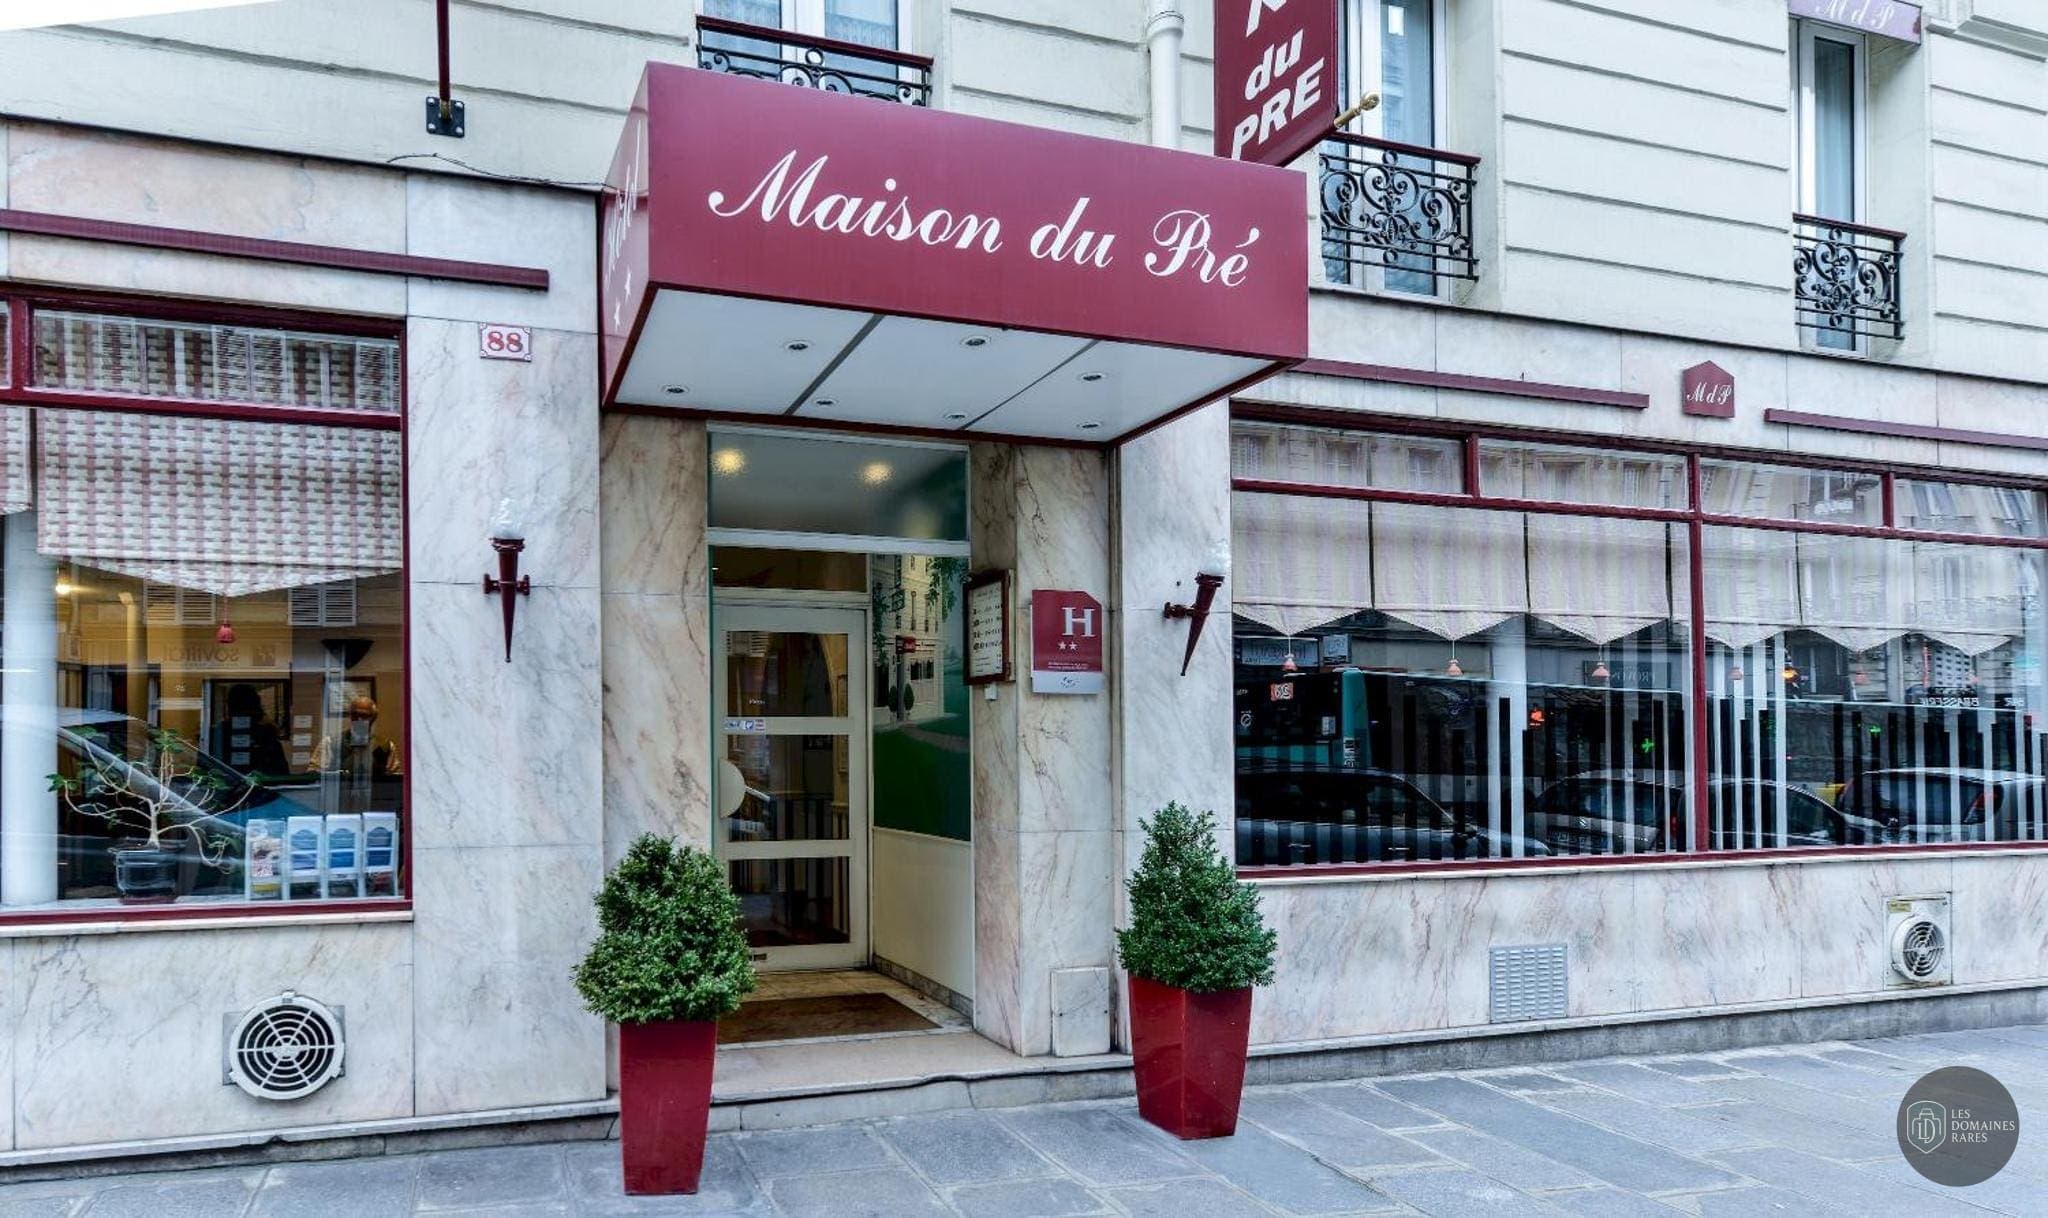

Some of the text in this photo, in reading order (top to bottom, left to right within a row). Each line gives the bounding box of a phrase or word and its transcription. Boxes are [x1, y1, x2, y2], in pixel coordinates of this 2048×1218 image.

[1244, 28, 1304, 100] du
[1231, 57, 1325, 161] PRE
[707, 149, 1261, 287] Maison du Pré
[487, 331, 523, 353] 88
[1061, 606, 1096, 638] H
